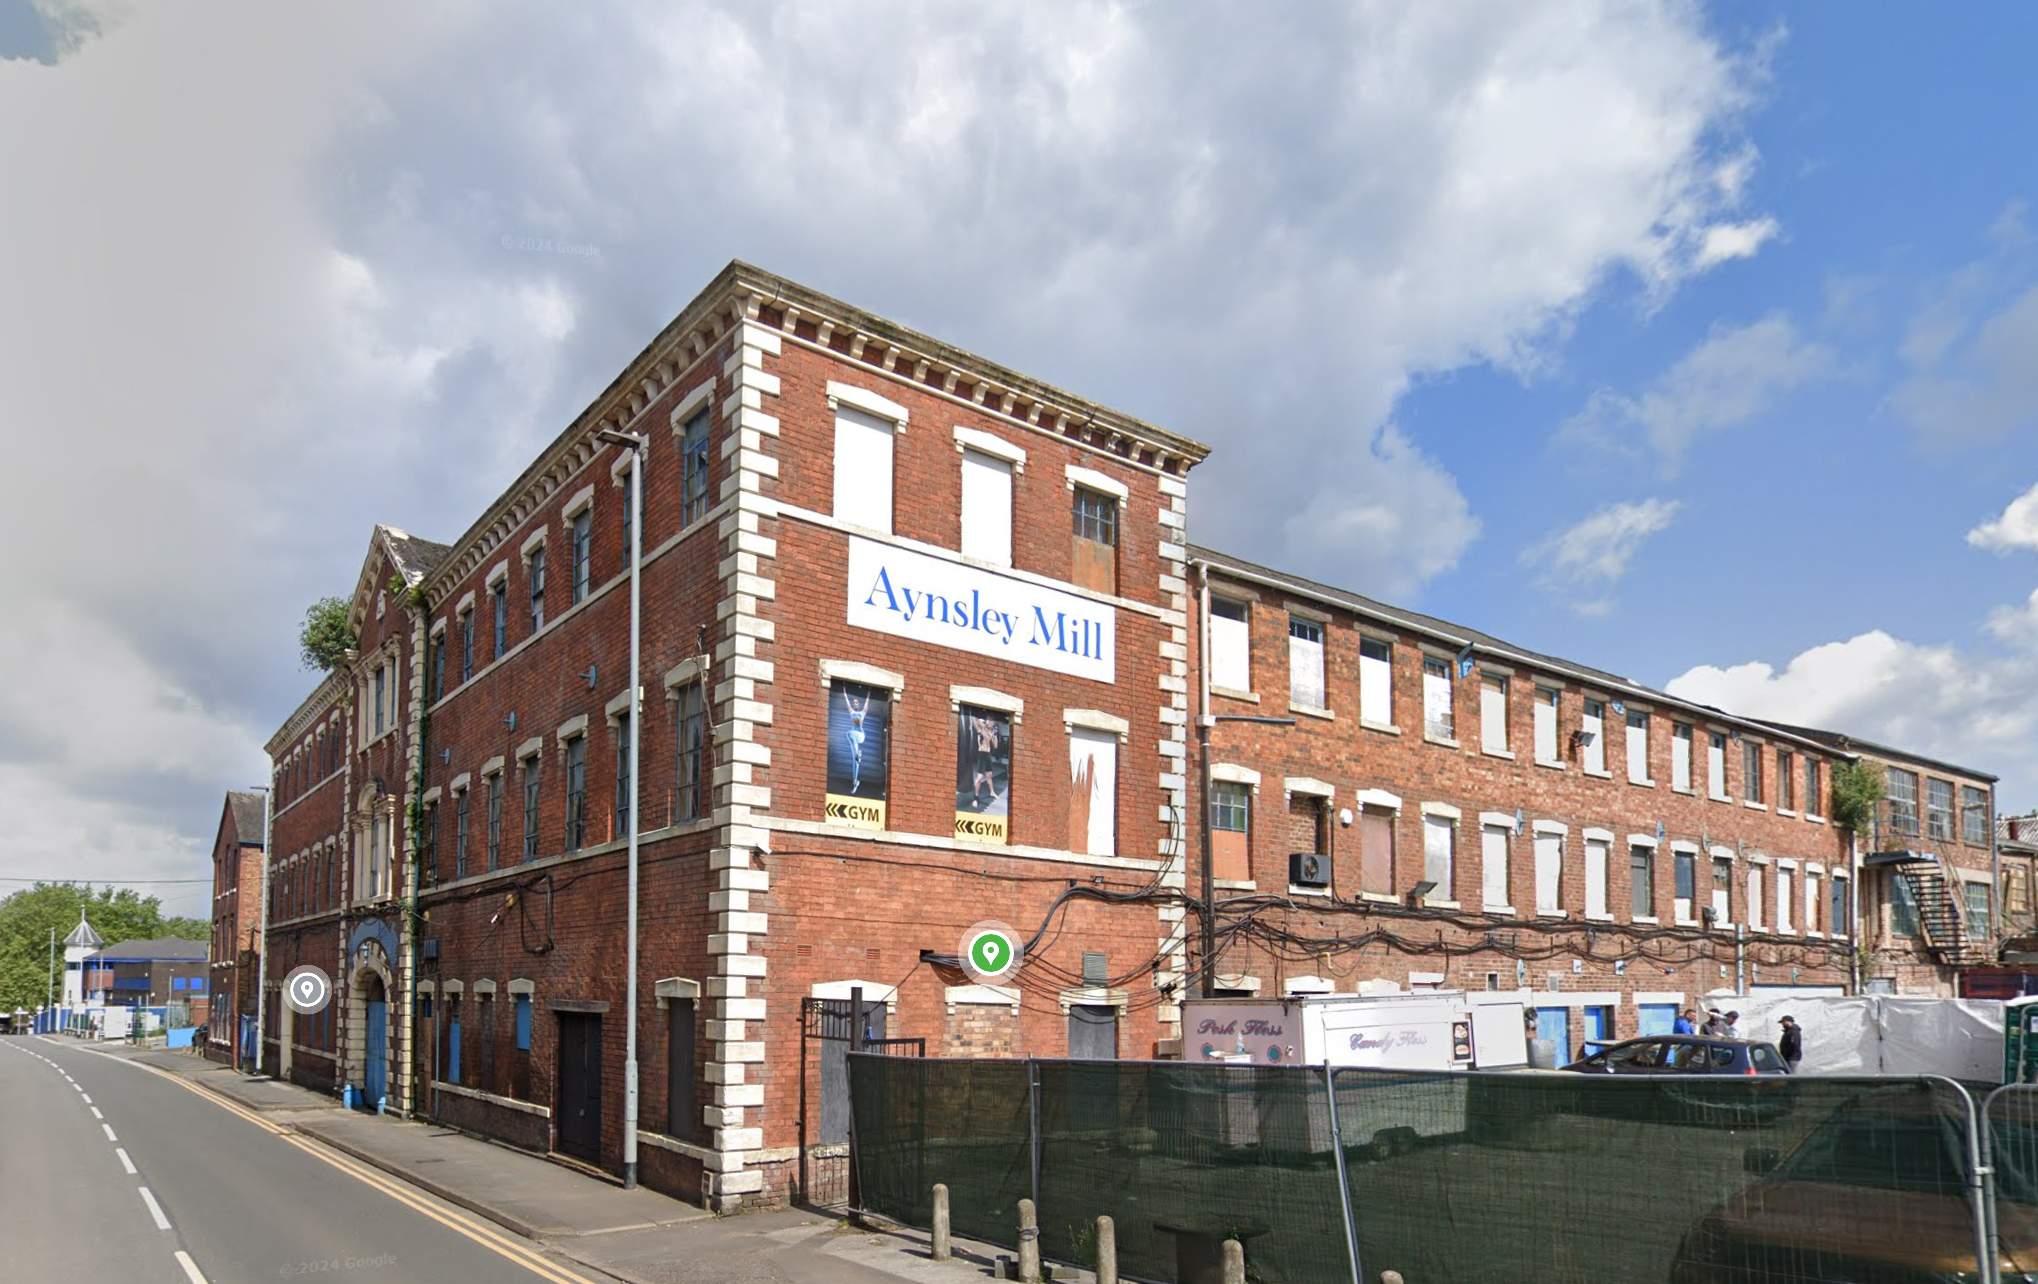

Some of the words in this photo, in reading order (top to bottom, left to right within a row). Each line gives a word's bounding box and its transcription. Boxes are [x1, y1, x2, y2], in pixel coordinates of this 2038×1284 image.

[864, 566, 1020, 645] Aynsley
[1029, 605, 1102, 660] Mill
[848, 805, 880, 823] GYM
[975, 821, 1003, 837] GYM
[1197, 1019, 1237, 1035] Posh
[1241, 1019, 1283, 1036] Floss
[1349, 1032, 1394, 1054] Candy
[1396, 1031, 1428, 1047] Floss
